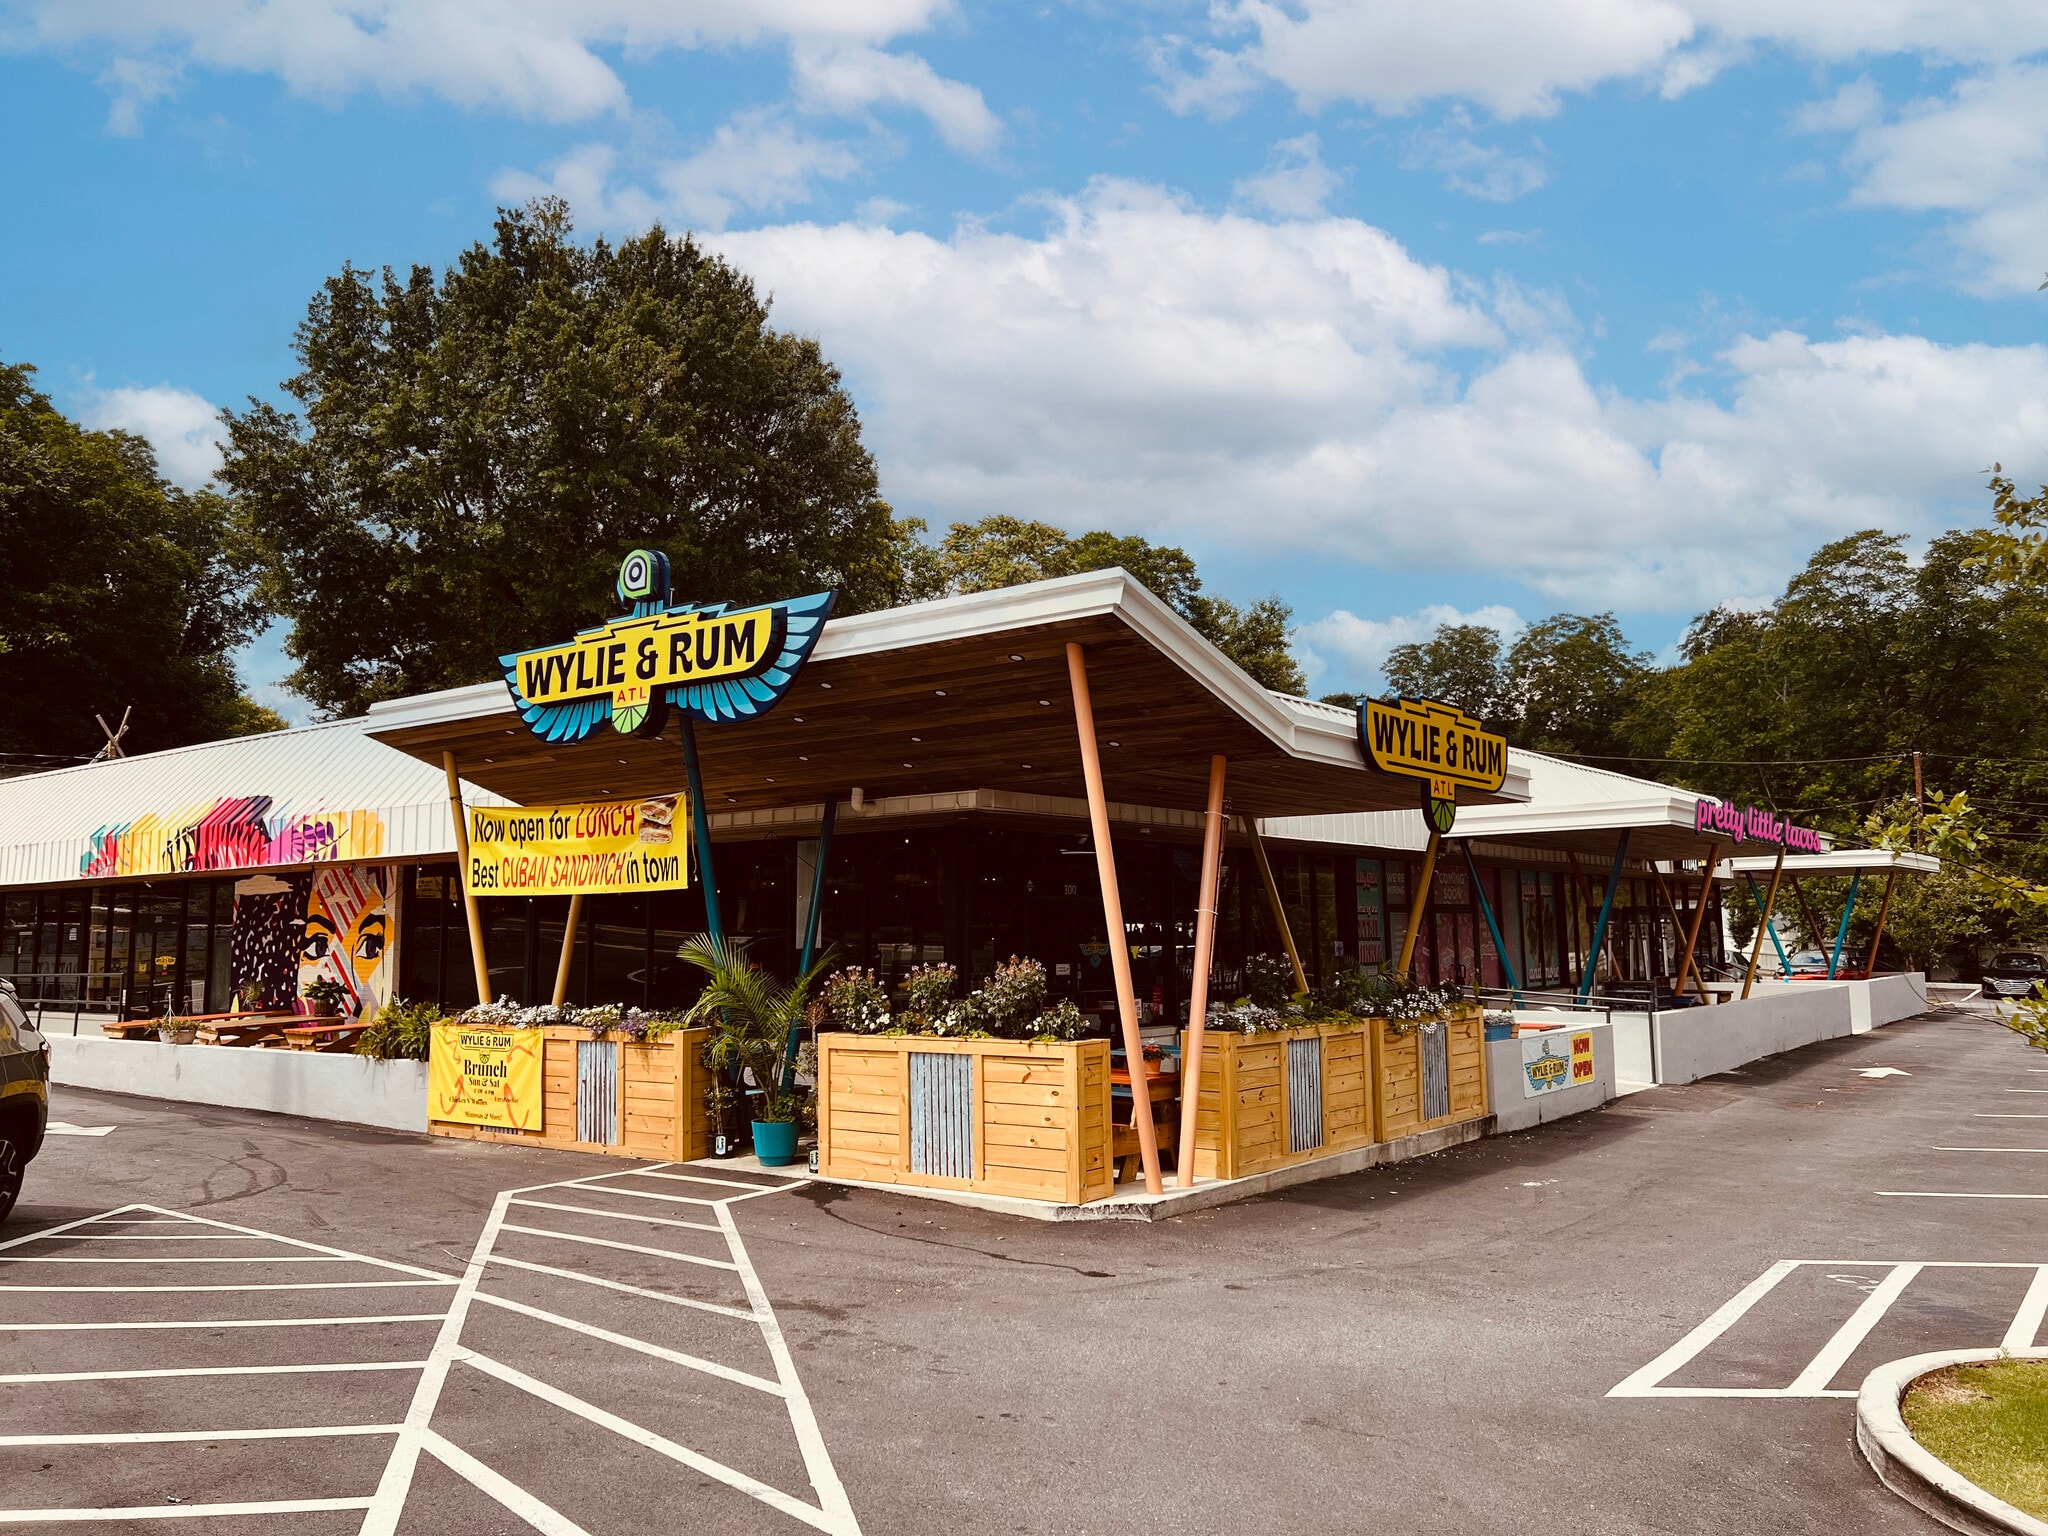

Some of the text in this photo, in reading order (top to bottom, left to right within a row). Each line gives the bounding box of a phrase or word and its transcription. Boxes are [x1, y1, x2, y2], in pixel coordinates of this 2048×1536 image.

[525, 618, 756, 699] WYLIE & RUM
[616, 686, 647, 704] ATL
[1373, 711, 1502, 777] WYLIE & RUM
[1433, 779, 1453, 796] ATL
[474, 804, 637, 849] Now open for LUNCH
[1696, 800, 1821, 852] pretty little tacos
[471, 858, 499, 889] Best
[502, 856, 549, 888] CUBAN
[550, 852, 628, 888] SANDWICH
[626, 851, 640, 884] in
[642, 851, 679, 884] town
[1386, 872, 1405, 883] WE'RE
[1438, 872, 1465, 885] COMING
[1063, 884, 1077, 895] 300
[1386, 885, 1405, 895] HIRING
[1443, 887, 1462, 900] SOON
[460, 1034, 511, 1047] WYLIE & RUM
[1573, 1037, 1590, 1055] NOW
[464, 1059, 507, 1078] Brunch
[1573, 1059, 1592, 1078] OPEN
